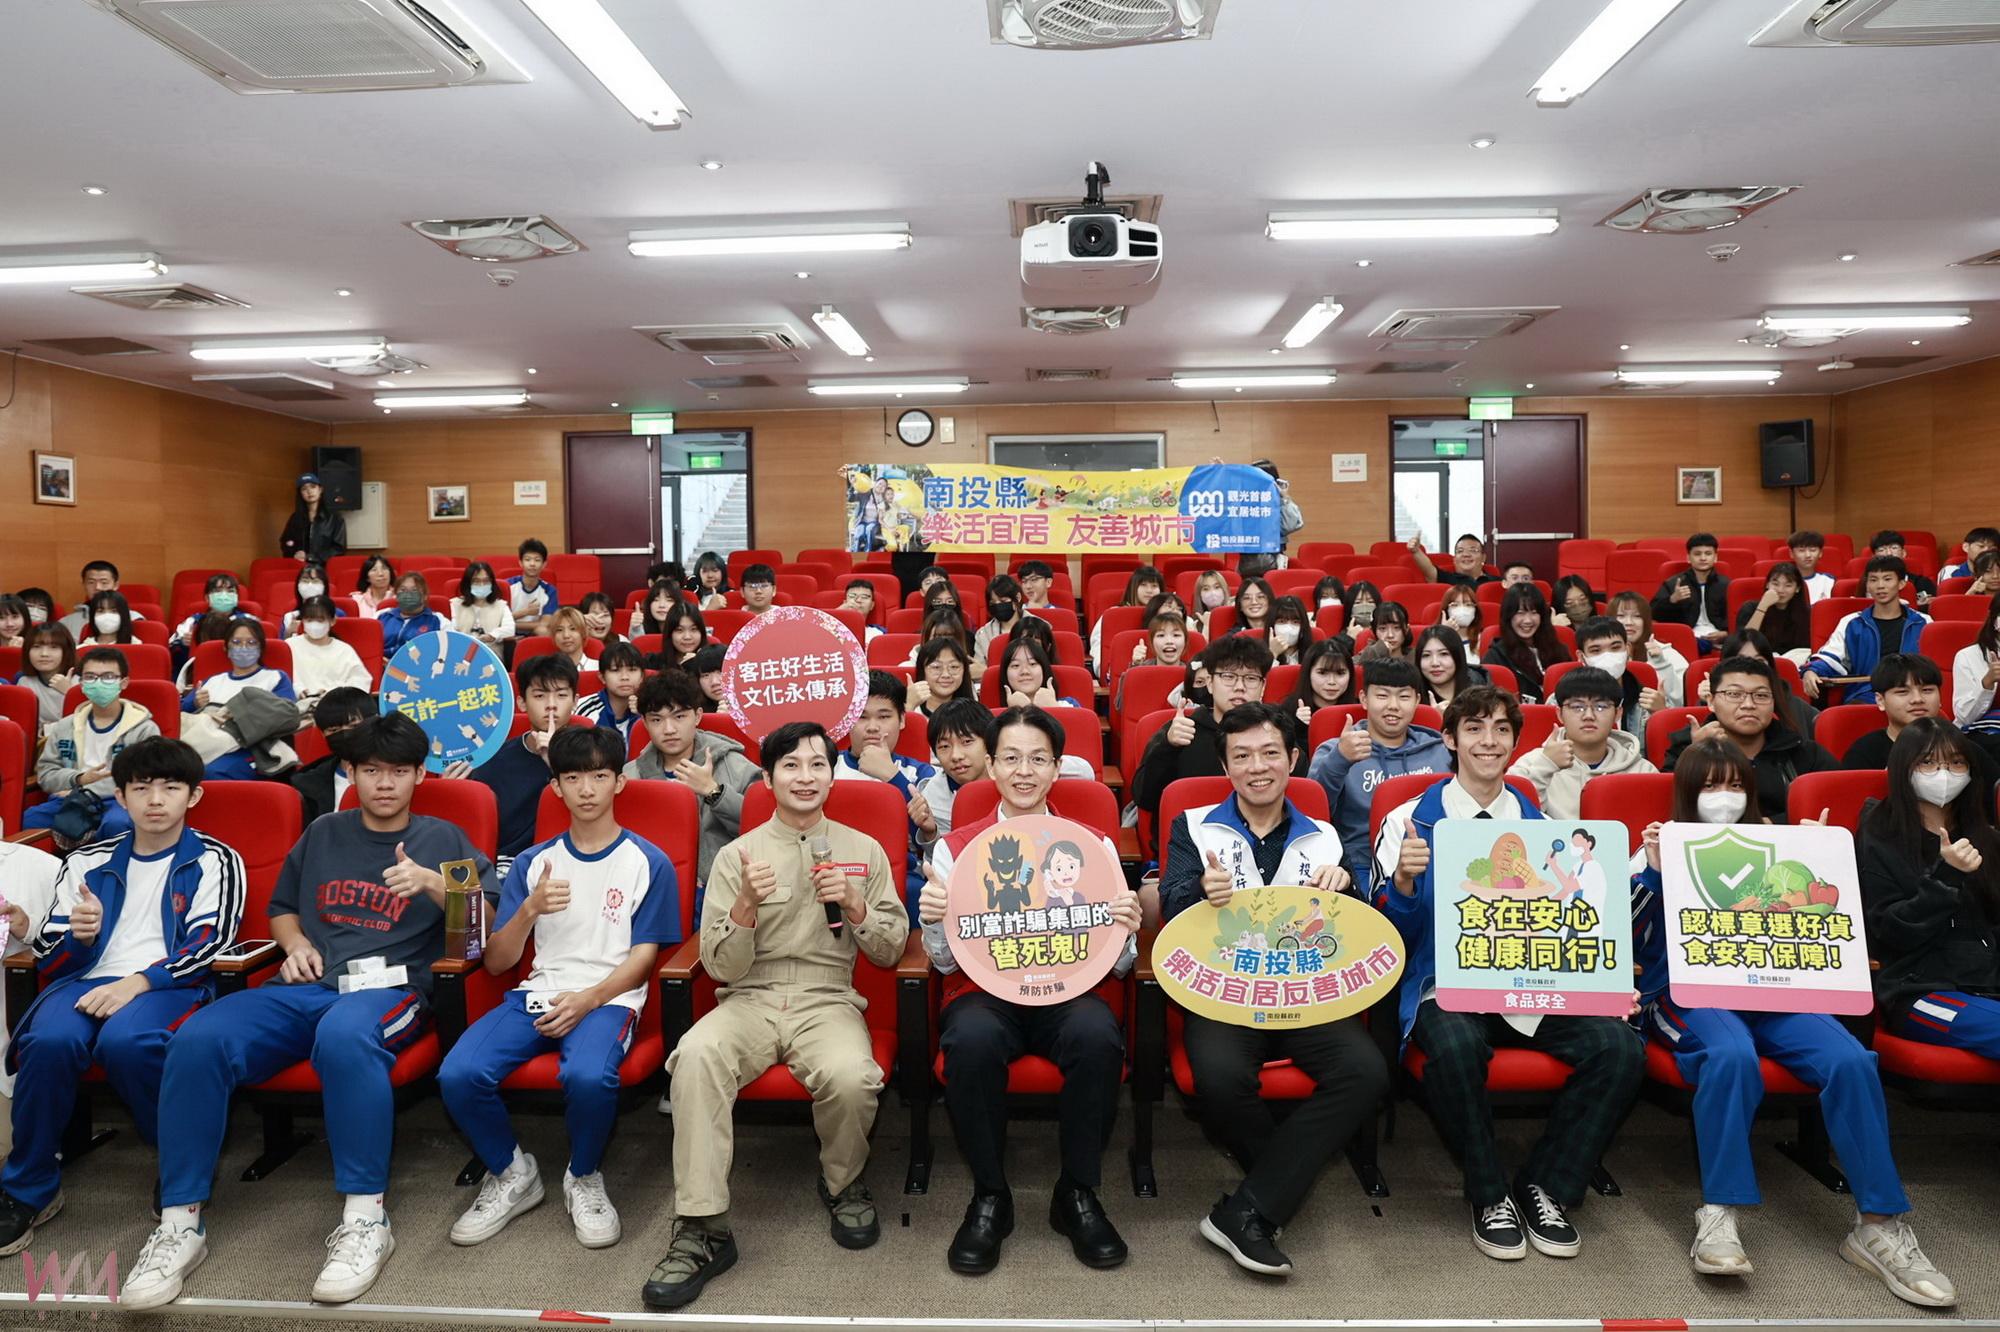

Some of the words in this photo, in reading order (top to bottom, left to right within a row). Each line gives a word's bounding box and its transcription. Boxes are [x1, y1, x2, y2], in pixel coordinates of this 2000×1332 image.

[923, 476, 1028, 508] 南投縣
[1227, 490, 1272, 502] 觀光首都
[1227, 506, 1271, 518] 宜居城市
[921, 512, 1049, 545] 樂活宜居
[1066, 513, 1196, 546] 友善城市
[738, 651, 845, 683] 客庄好生活
[741, 677, 848, 709] 文化永傳承
[958, 902, 1114, 940] 別當詐騙集團的
[1454, 894, 1600, 932] 食在安心
[1679, 907, 1856, 941] 認標章選好貨
[1162, 943, 1399, 1008] 樂活宜居友善城市
[1233, 947, 1325, 976] 南投縣
[1018, 982, 1066, 997] 預防詐騙
[1504, 992, 1566, 1009] 食品安全
